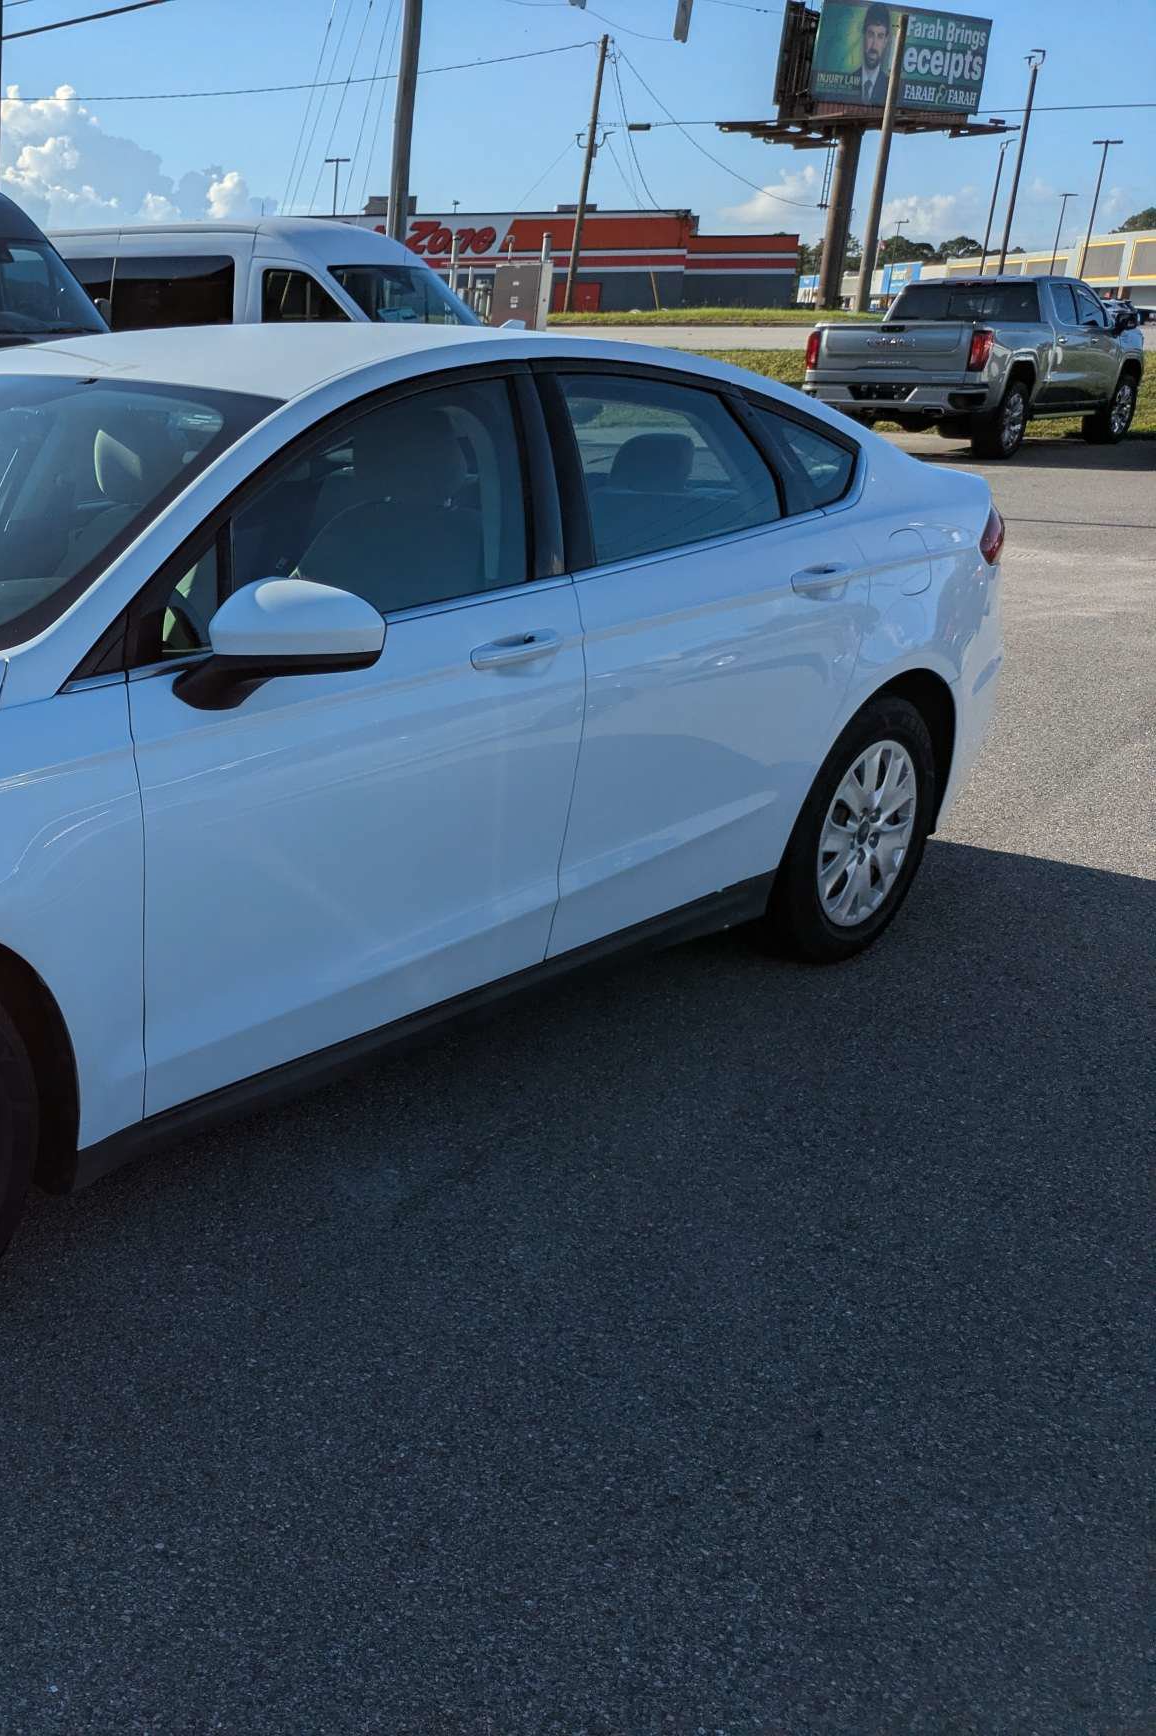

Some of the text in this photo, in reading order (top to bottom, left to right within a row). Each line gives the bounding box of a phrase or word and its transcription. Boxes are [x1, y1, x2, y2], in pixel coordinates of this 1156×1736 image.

[906, 15, 987, 50] Farah Brings
[904, 84, 936, 102] FARAH
[947, 89, 978, 106] FARAH
[405, 221, 497, 255] Zone
